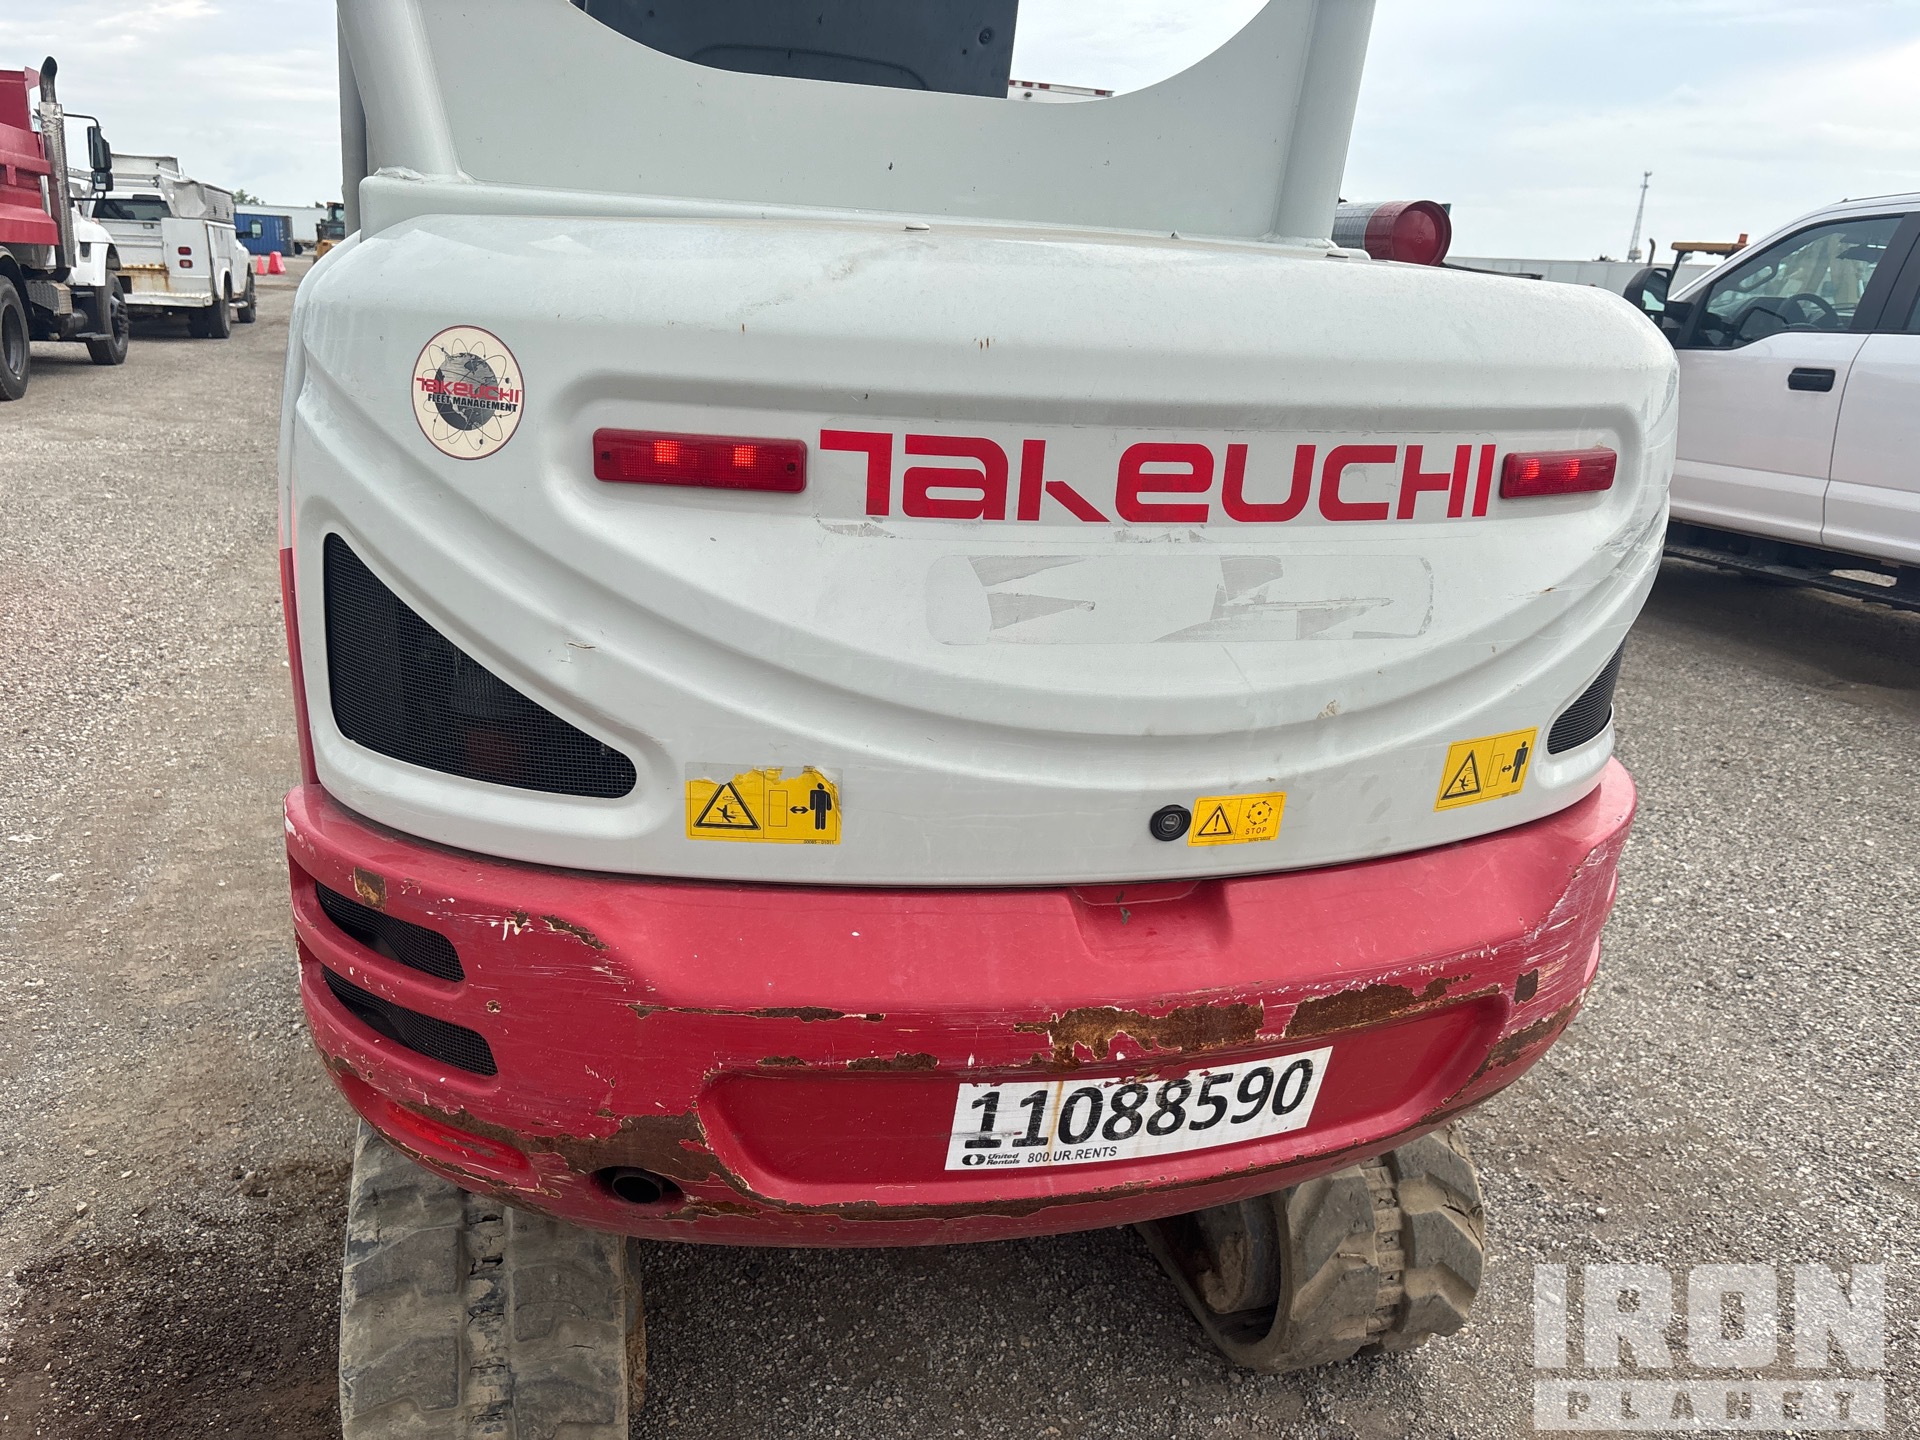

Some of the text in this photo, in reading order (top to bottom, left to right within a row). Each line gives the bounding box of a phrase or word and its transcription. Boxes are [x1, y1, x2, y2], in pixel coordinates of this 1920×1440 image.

[428, 393, 518, 412] FLEET MANAGEMENT
[1245, 826, 1267, 835] STOP
[965, 1058, 1313, 1149] 11088590
[1027, 1146, 1118, 1163] 800.UR.RENTS
